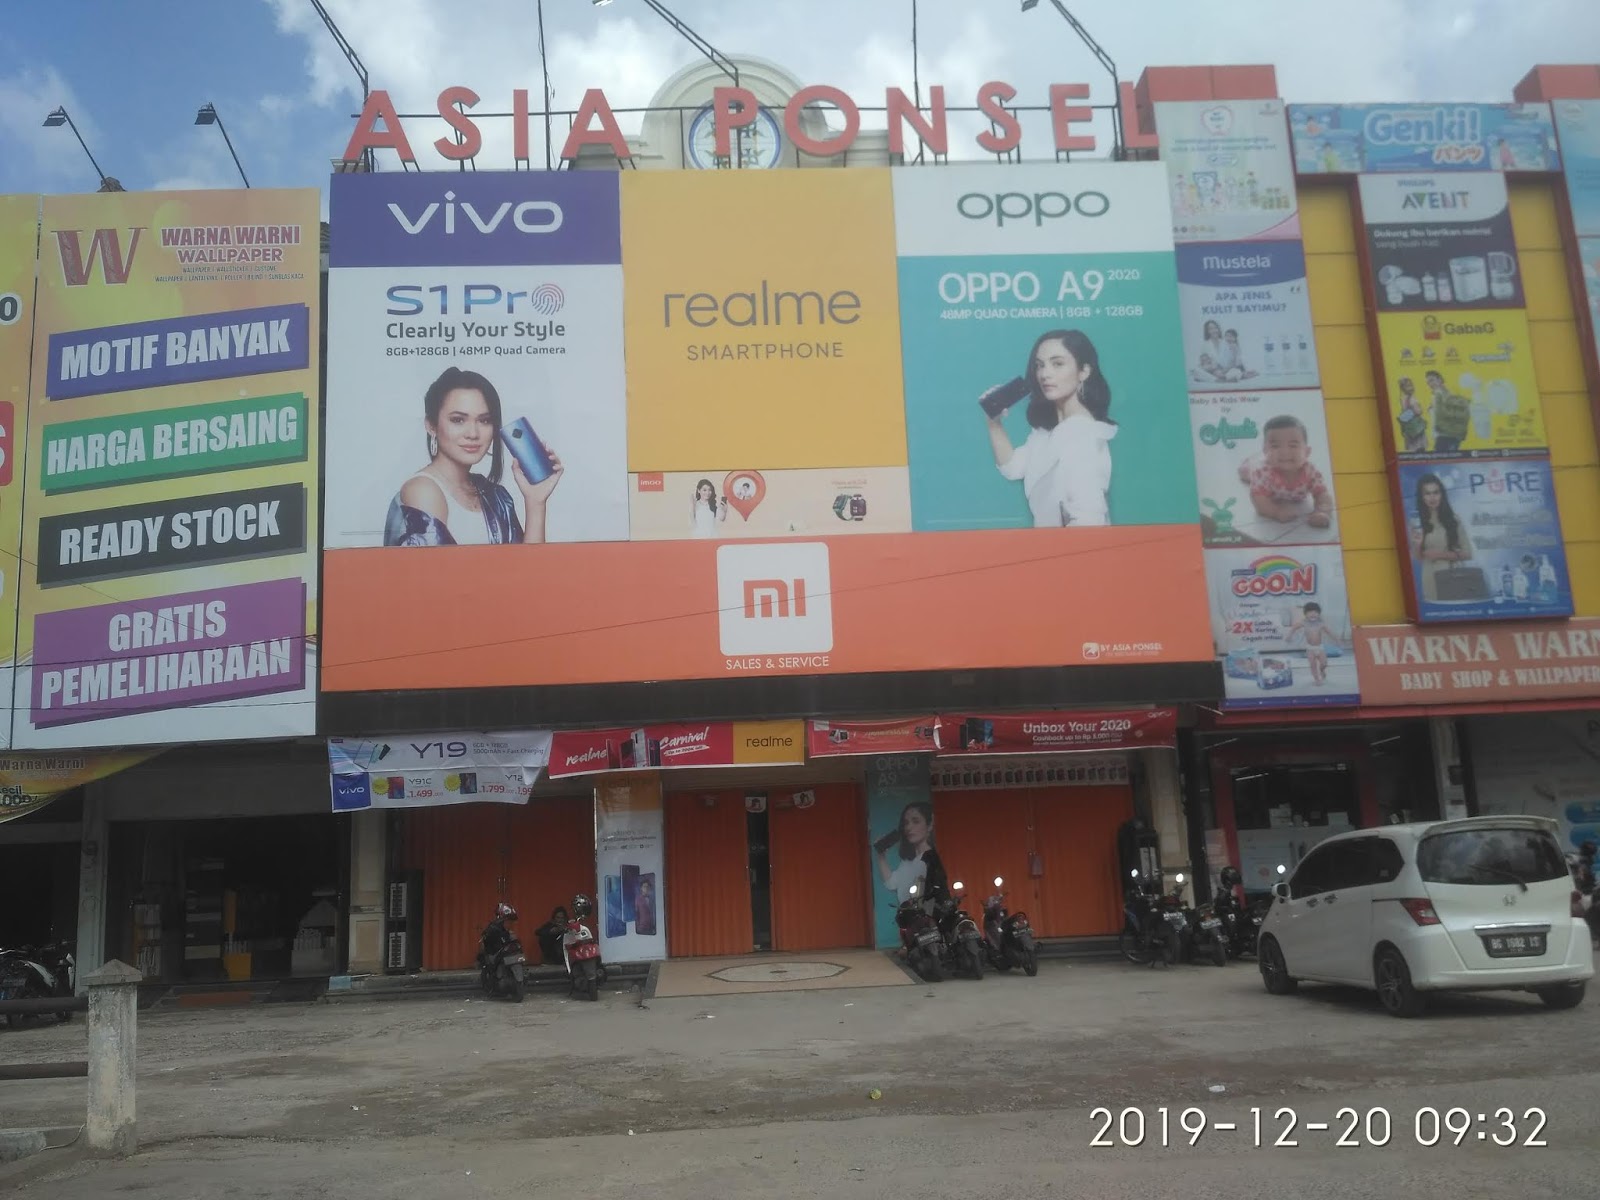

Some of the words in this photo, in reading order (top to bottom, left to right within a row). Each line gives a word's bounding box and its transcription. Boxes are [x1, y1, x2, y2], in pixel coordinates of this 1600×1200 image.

[342, 86, 633, 162] ASIA
[713, 81, 1160, 156] PONSEL
[1365, 108, 1482, 146] Genki!
[1401, 191, 1470, 210] AVENT
[387, 191, 564, 234] vivo
[161, 227, 231, 246] WARNA
[235, 225, 301, 244] WARNI
[177, 248, 283, 263] WALLPAPER
[938, 271, 1040, 304] OPPO
[1056, 270, 1104, 301] A9
[1107, 269, 1140, 281] 2020
[1215, 292, 1238, 300] APA
[1242, 291, 1272, 300] JENIS
[386, 285, 448, 316] S1
[663, 279, 861, 328] realme
[1201, 305, 1232, 314] KULIT
[940, 309, 972, 320] 48MP
[974, 308, 1007, 319] QUAD
[1009, 307, 1057, 318] CAMERA
[1066, 306, 1091, 318] 8GB
[1105, 305, 1144, 316] 128GB
[386, 322, 456, 342] Clearly
[462, 322, 509, 338] Your
[513, 320, 566, 341] Style
[1444, 322, 1495, 335] GabaG
[60, 335, 159, 381] MOTIF
[165, 318, 291, 366] BANYAK
[386, 347, 450, 356] 8GB+128GB
[459, 346, 491, 356] 48MP
[494, 346, 523, 356] Quad
[525, 345, 566, 354] Camera
[687, 342, 844, 361] SMARTPHONE
[47, 427, 146, 476] HARGA
[153, 406, 298, 460] BERSAING
[59, 516, 164, 565] READY
[171, 500, 281, 550] STOCK
[108, 600, 227, 652] GRATIS
[1232, 620, 1254, 634] 2X
[1113, 643, 1131, 651] ASIA
[1368, 634, 1498, 665] WARNA
[726, 659, 761, 670] SALES
[766, 659, 775, 668] &
[779, 656, 829, 668] SERVICE
[41, 638, 290, 709] PEMELIHARAAN
[1401, 672, 1442, 690] BABY
[1453, 670, 1493, 688] SHOP
[1498, 670, 1510, 685] &
[1023, 723, 1065, 733] Unbox
[1069, 722, 1097, 731] Your
[1100, 720, 1131, 731] 2020
[410, 741, 467, 758] Y19
[566, 747, 607, 766] realme
[660, 727, 710, 750] Carnival
[746, 735, 793, 747] realme
[44, 757, 86, 769] Warni
[0, 785, 22, 795] ecil
[339, 786, 365, 795] vivo
